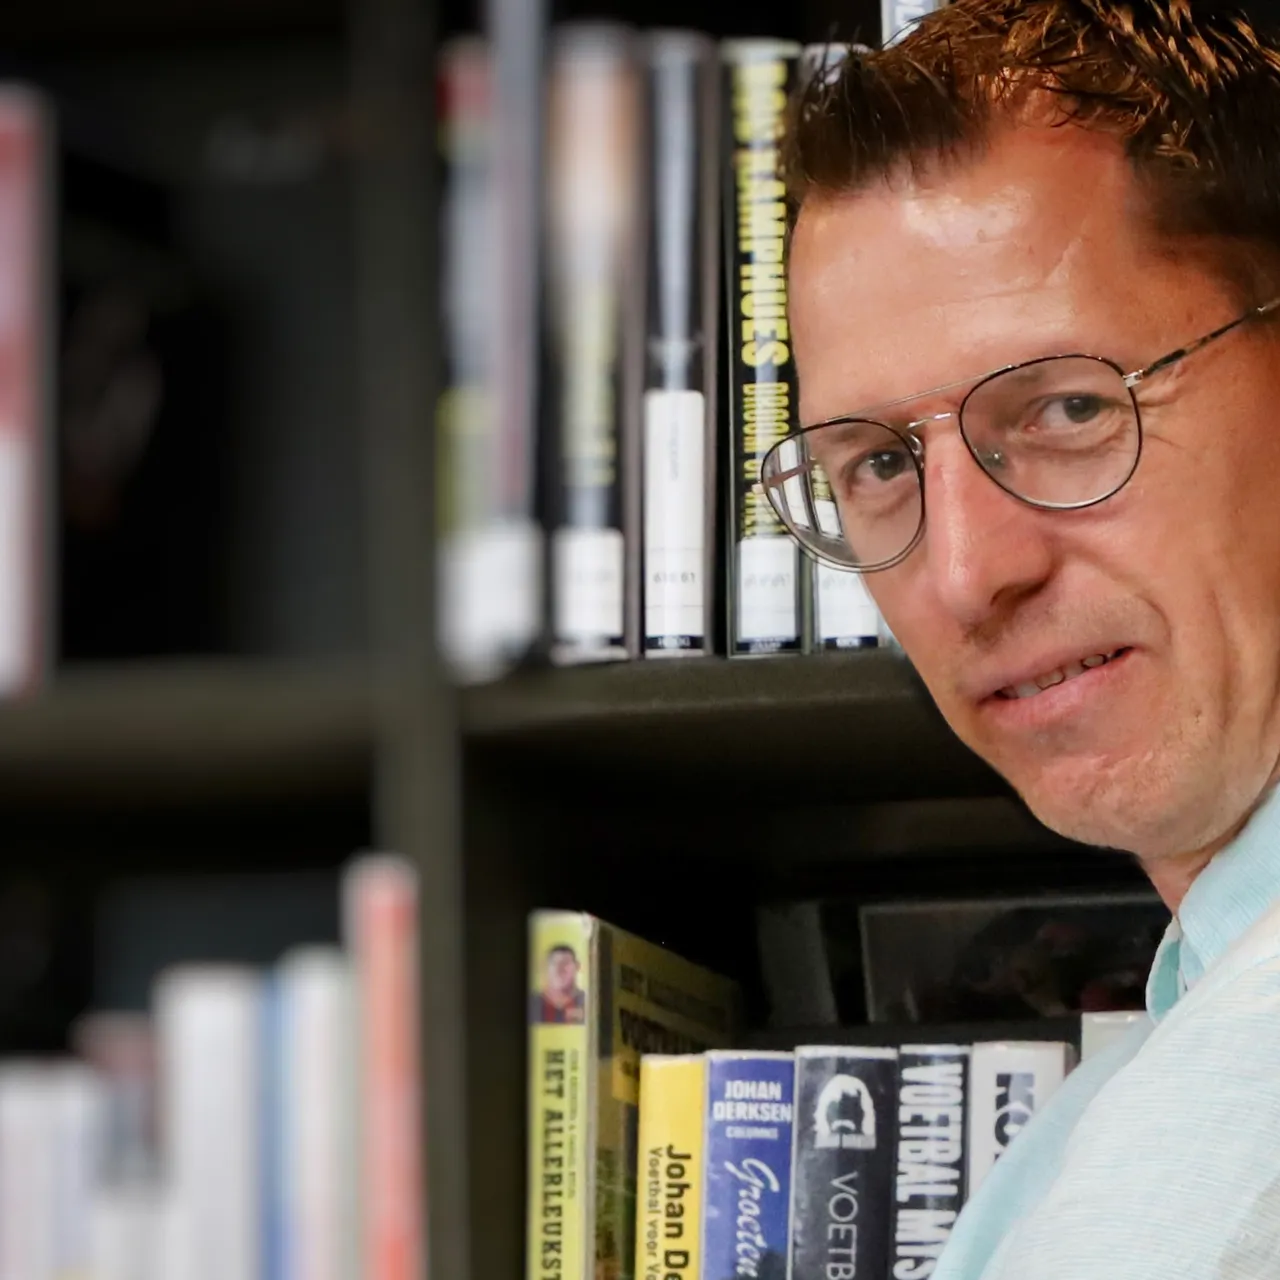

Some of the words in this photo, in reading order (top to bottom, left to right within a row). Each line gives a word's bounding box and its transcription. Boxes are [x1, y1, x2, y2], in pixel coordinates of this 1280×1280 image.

[543, 1050, 565, 1099] HET
[724, 1079, 782, 1100] JOHAN
[712, 1101, 793, 1123] DERKSEN
[895, 1062, 964, 1204] VOETBAL
[665, 1144, 694, 1239] Johan
[644, 1219, 659, 1258] voor
[724, 1157, 780, 1280] Groeten
